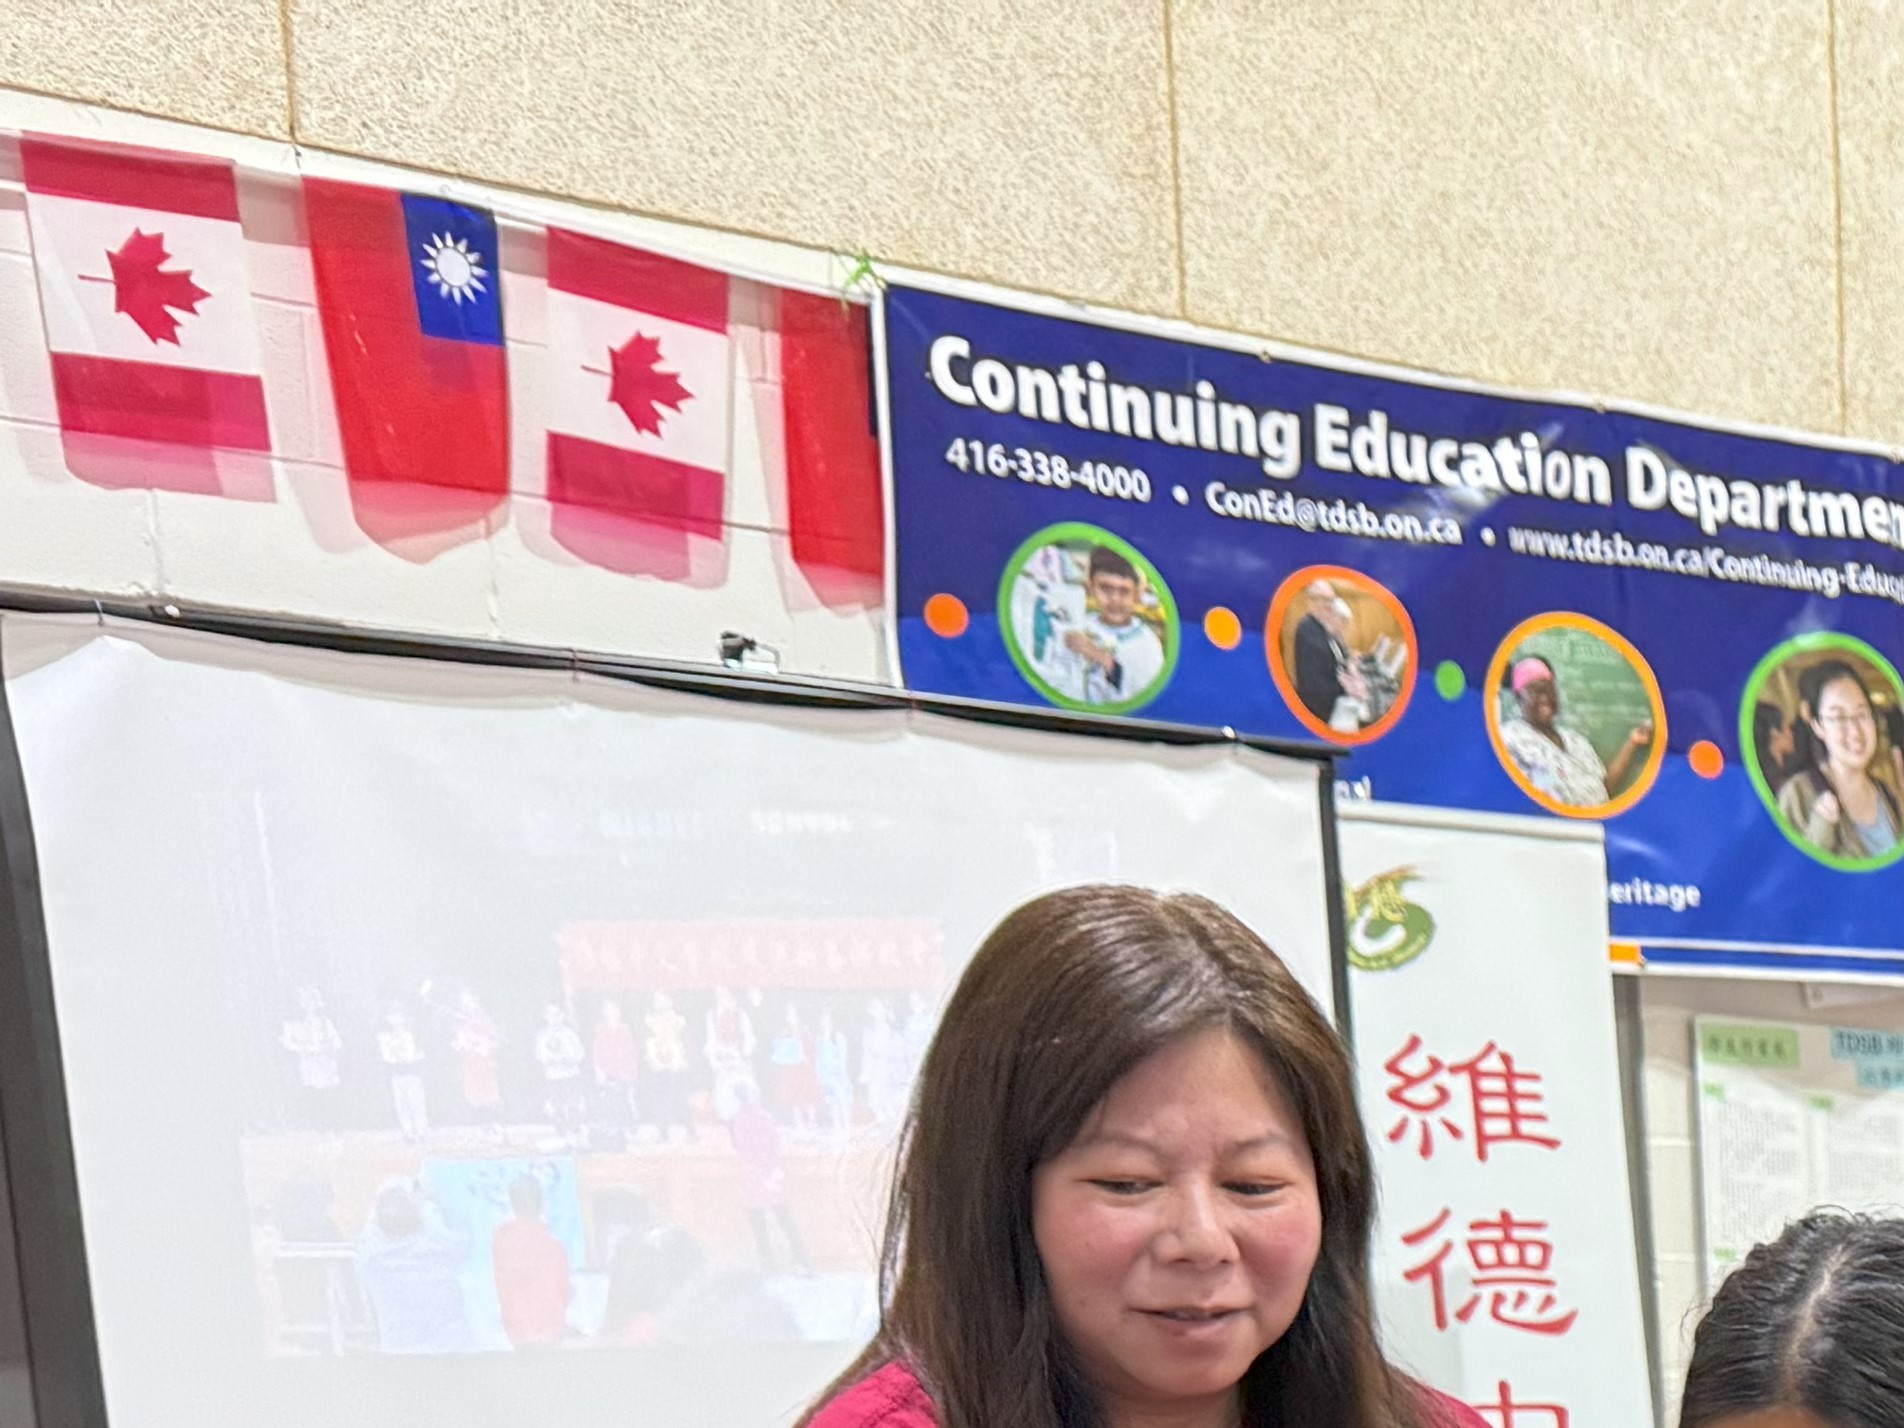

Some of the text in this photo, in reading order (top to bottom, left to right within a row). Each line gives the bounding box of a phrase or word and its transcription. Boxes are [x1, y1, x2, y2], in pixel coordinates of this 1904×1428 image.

[929, 335, 1301, 479] Continuing
[1314, 403, 1612, 505] Education
[945, 437, 1152, 503] 416-338-4000
[1206, 481, 1463, 545] ConEd@tdsb.on.ca
[1608, 876, 1702, 912] eritage
